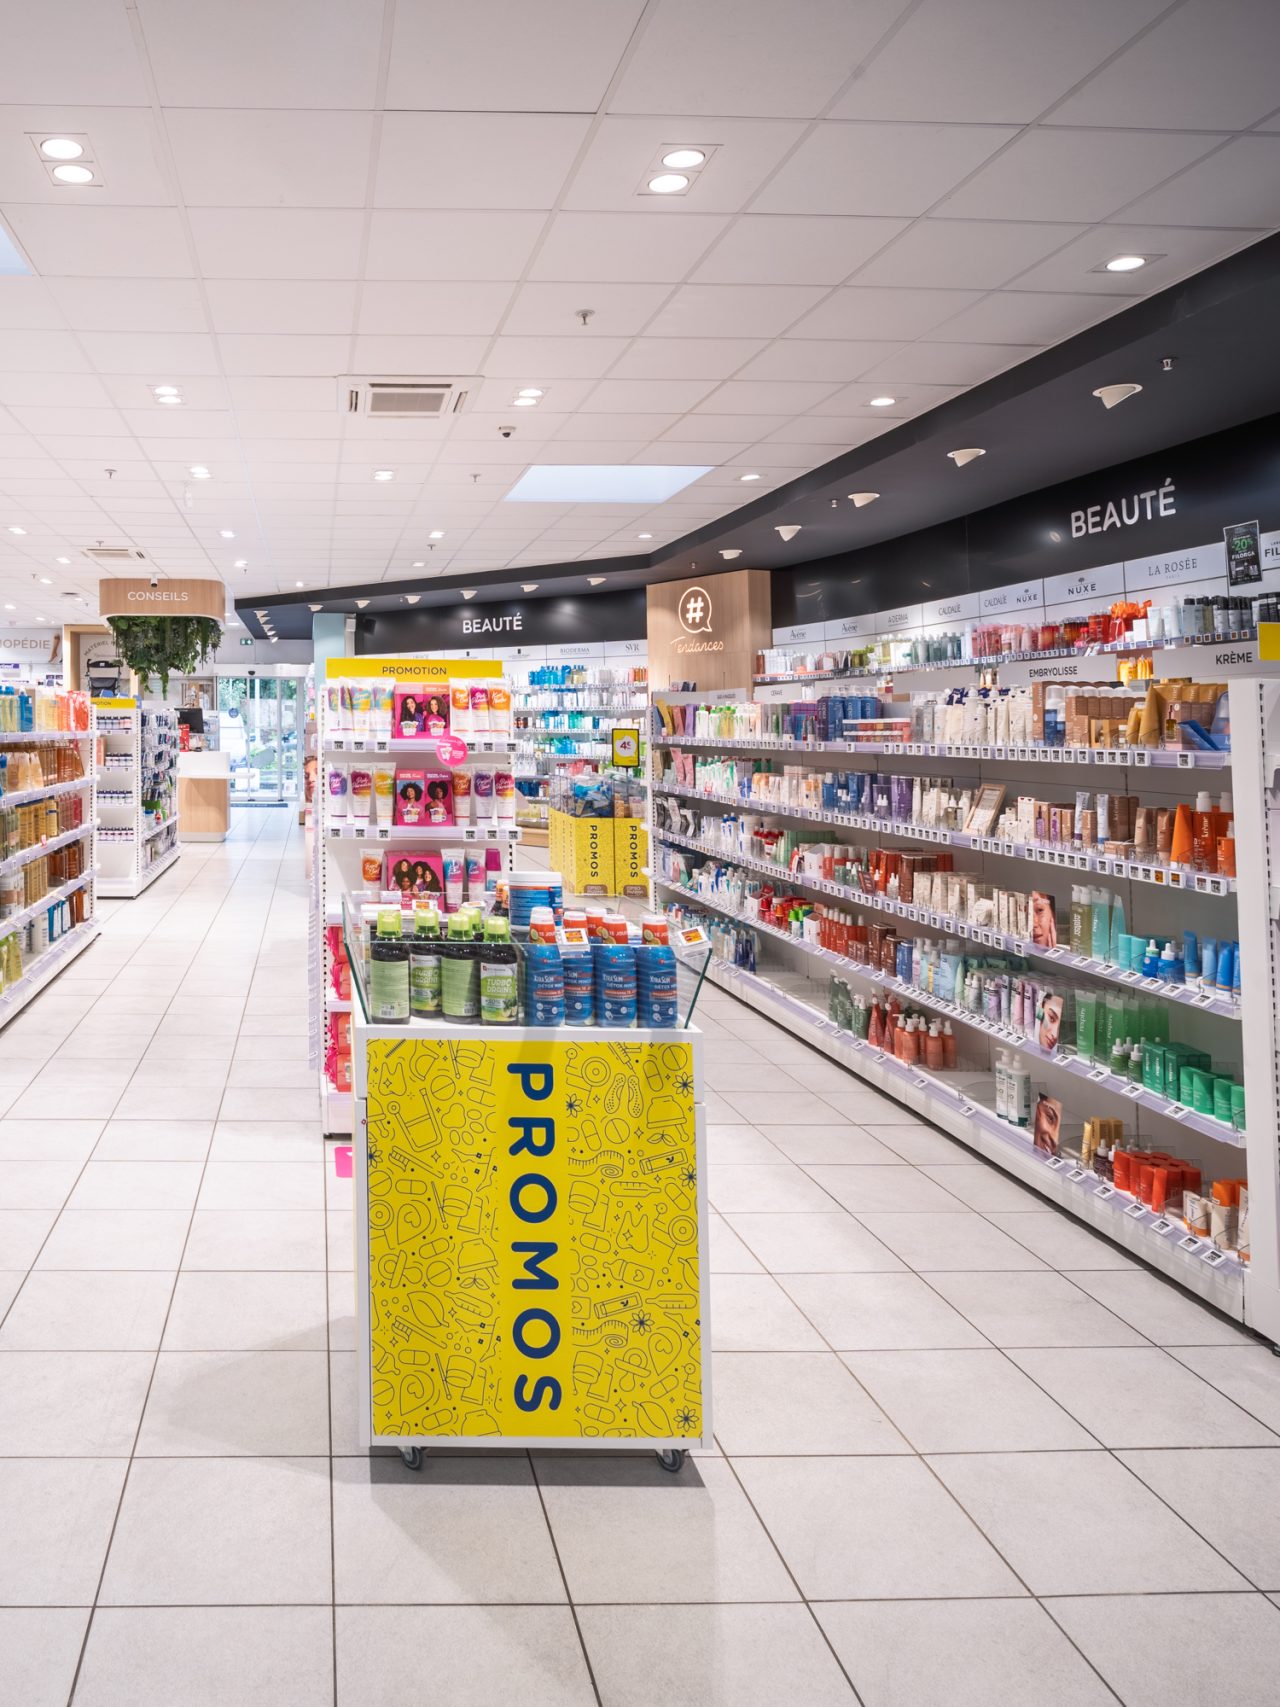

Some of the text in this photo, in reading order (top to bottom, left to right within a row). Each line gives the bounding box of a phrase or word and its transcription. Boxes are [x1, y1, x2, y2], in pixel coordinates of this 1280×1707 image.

[1071, 478, 1176, 538] BEAUTÉ
[1264, 547, 1280, 557] FIL
[1148, 557, 1198, 577] LA ROSÉE
[127, 591, 189, 601] CONSEILS
[1067, 583, 1097, 596] NUXE
[1016, 593, 1038, 604] NUXE
[463, 612, 523, 634] BEAUTÉ
[670, 636, 724, 654] Tendances
[1215, 651, 1253, 665] KRÈME
[382, 666, 447, 676] PROMOTION
[1029, 666, 1078, 678] EMBRYOLISSE
[590, 825, 599, 878] PROMOS
[629, 825, 638, 879] PROMOS
[486, 978, 512, 986] TURBO
[507, 1062, 562, 1413] PROMOS
